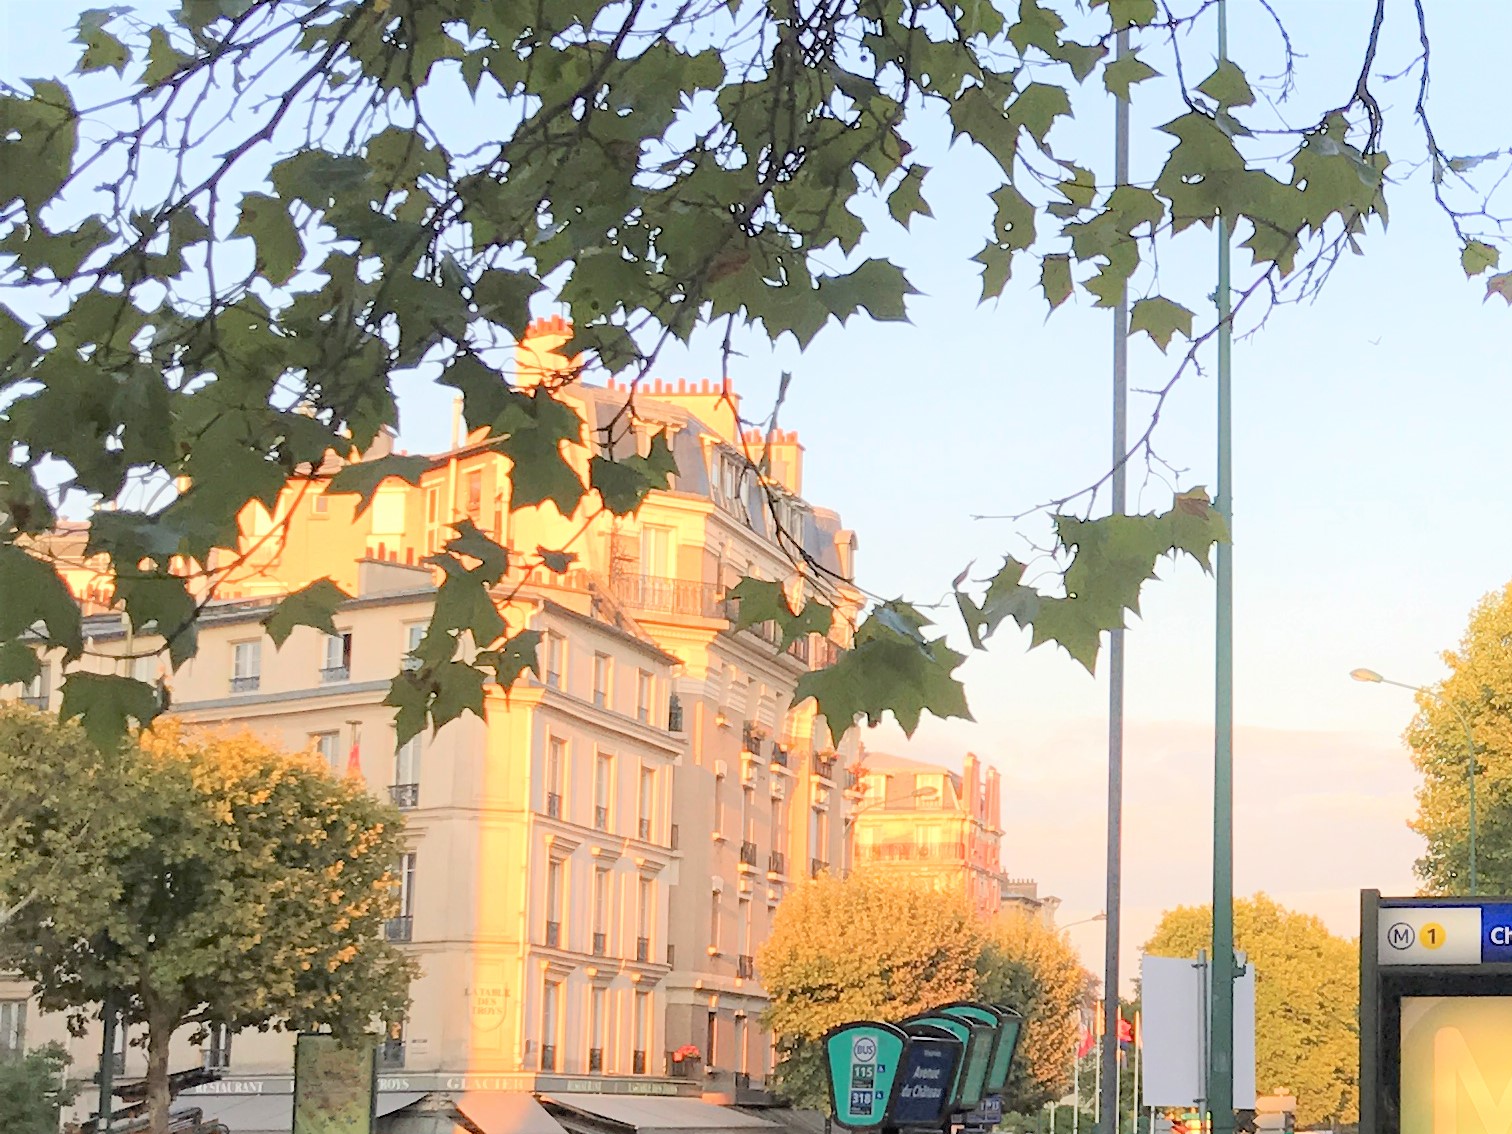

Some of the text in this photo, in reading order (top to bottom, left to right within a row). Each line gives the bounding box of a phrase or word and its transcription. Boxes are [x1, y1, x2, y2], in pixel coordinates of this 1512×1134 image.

[1428, 929, 1436, 944] 1
[857, 1045, 873, 1055] BUS
[854, 1067, 873, 1078] 115
[195, 1082, 264, 1094] RESTAURANT
[447, 1078, 524, 1090] GLACIER
[853, 1092, 871, 1104] 318
